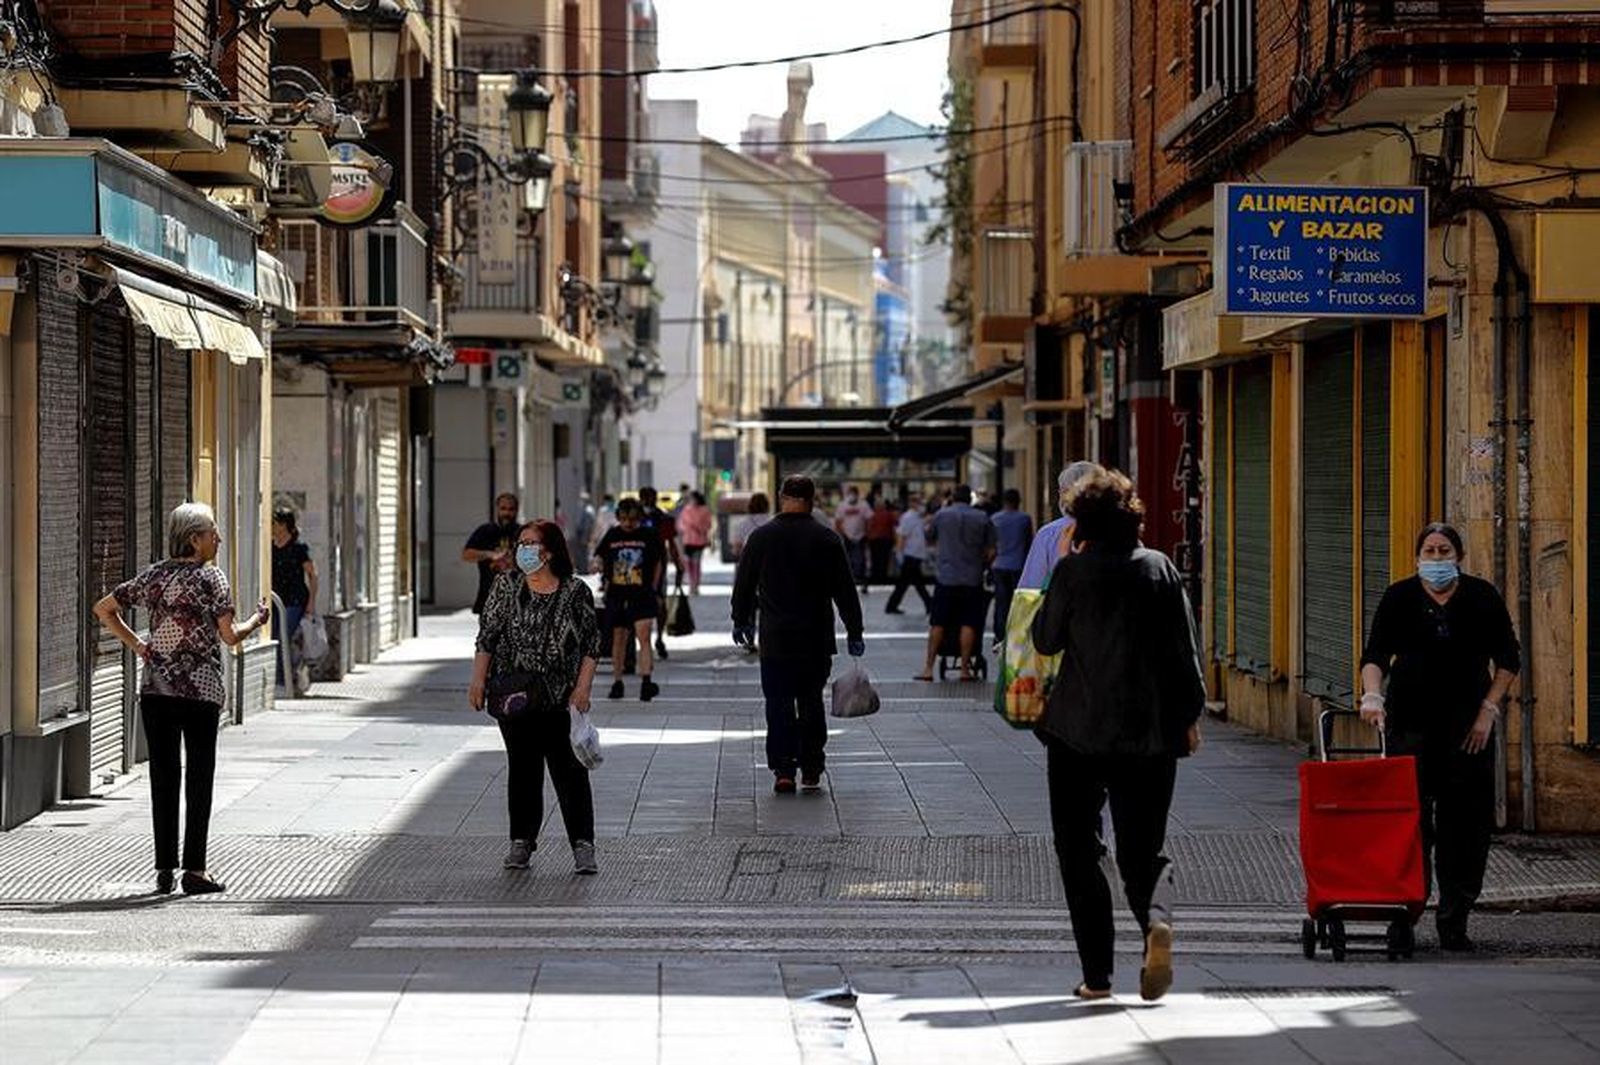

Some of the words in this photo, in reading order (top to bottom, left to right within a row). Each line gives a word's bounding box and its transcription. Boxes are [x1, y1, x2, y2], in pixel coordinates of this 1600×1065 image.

[1238, 193, 1414, 214] ALIMENTACION
[1269, 220, 1285, 238] Y
[1302, 221, 1383, 240] BAZAR
[1249, 245, 1291, 260] Textil
[1249, 265, 1304, 283] Regalos
[1249, 287, 1310, 305] Juguetes
[1328, 289, 1375, 304] Frutos
[1379, 294, 1416, 305] secos
